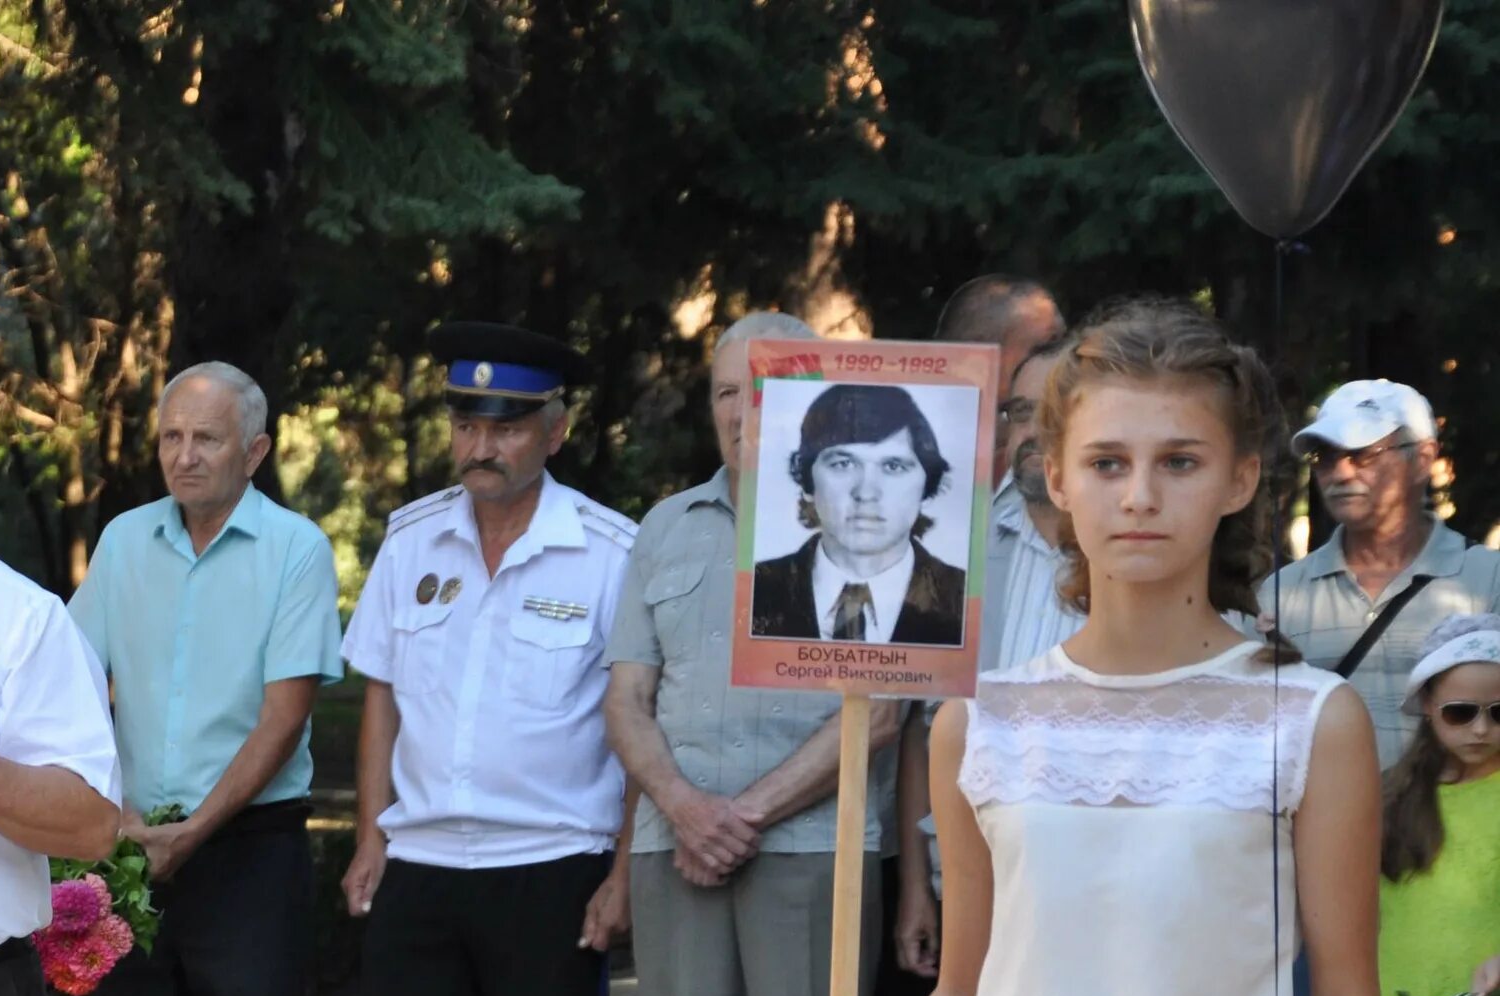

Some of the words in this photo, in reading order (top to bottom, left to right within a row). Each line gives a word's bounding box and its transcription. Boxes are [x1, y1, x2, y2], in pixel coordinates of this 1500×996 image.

[798, 646, 907, 665] БОУБАТРЫН
[775, 662, 833, 680] Сергей
[838, 667, 933, 683] Викторович
